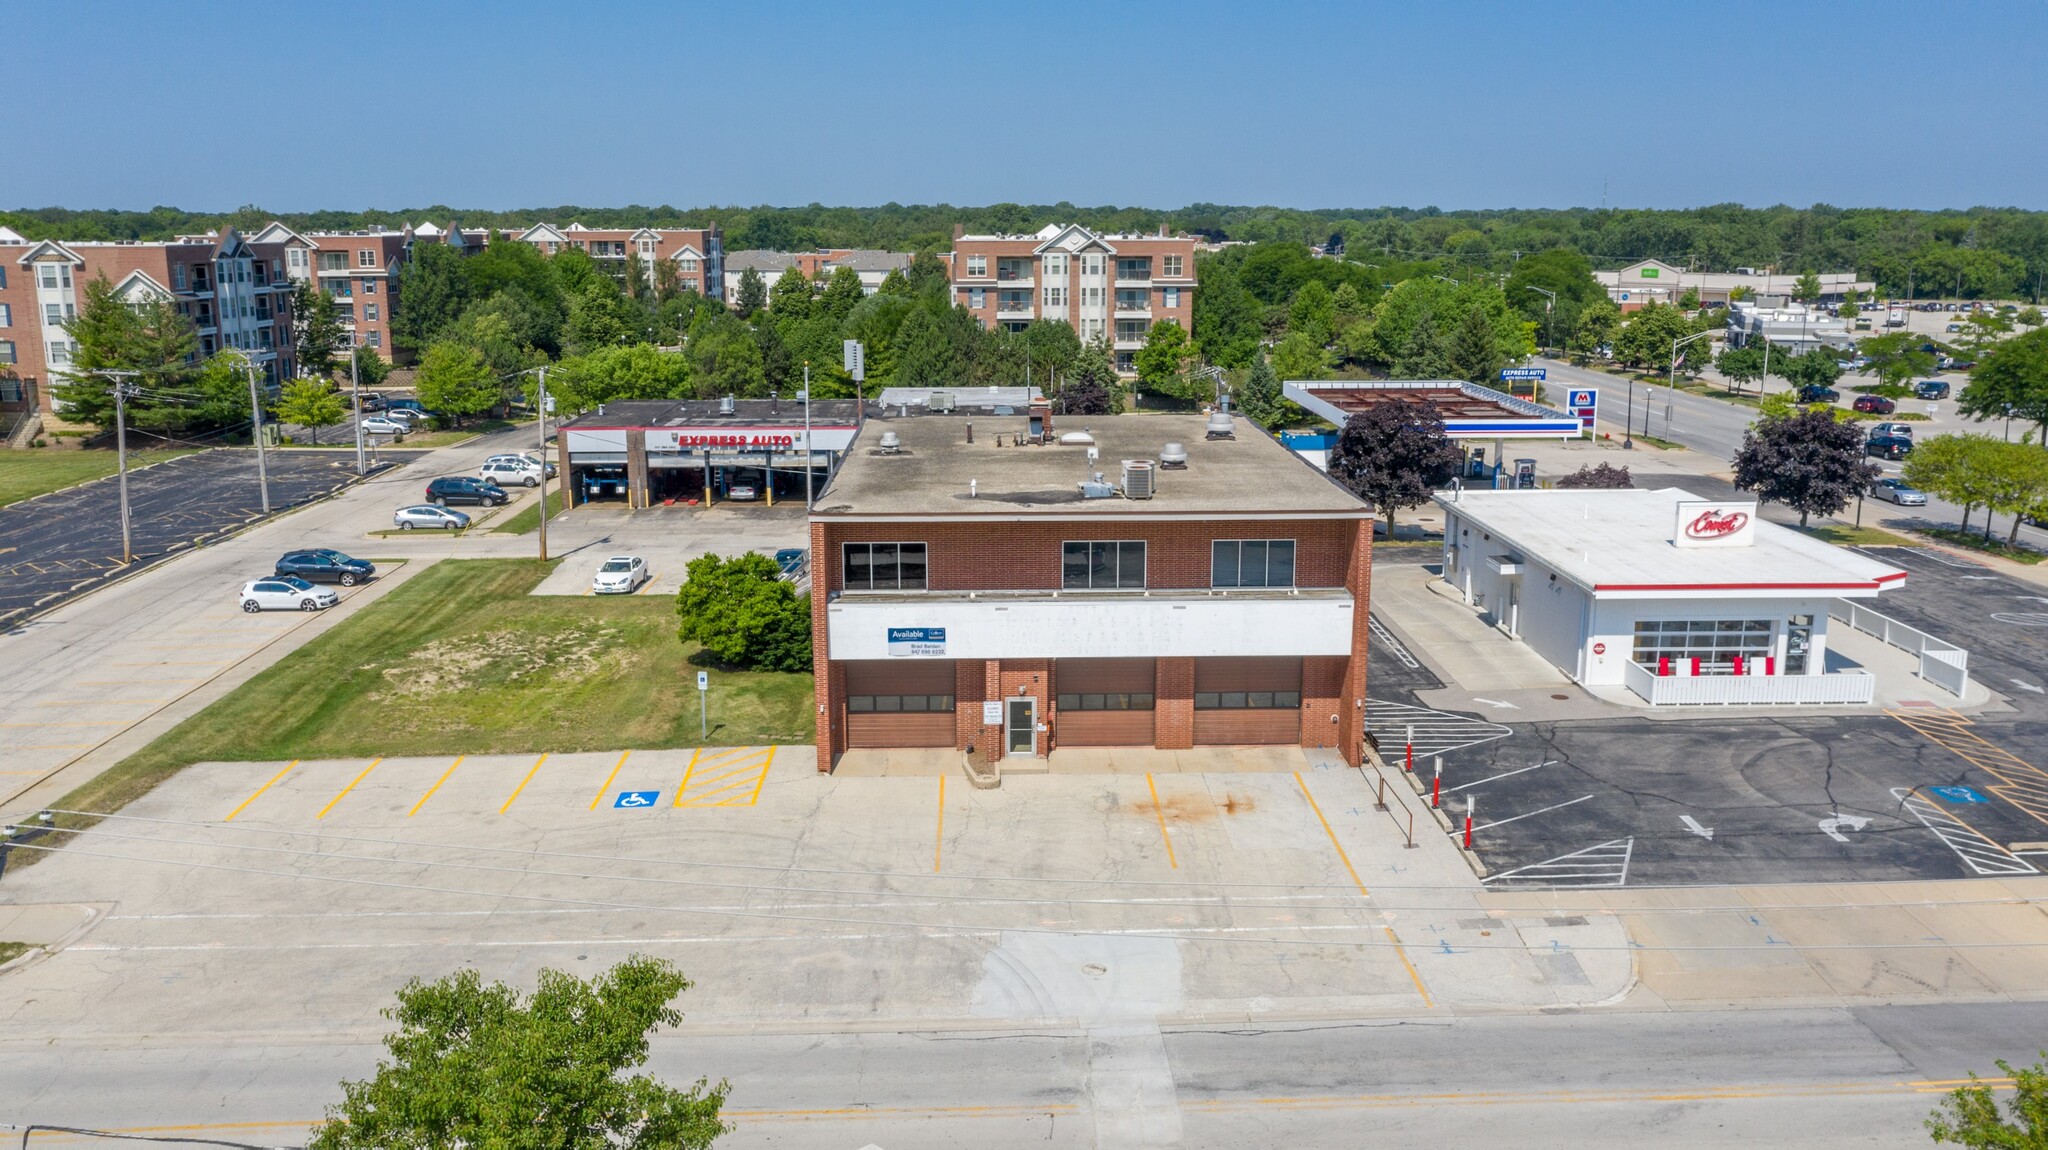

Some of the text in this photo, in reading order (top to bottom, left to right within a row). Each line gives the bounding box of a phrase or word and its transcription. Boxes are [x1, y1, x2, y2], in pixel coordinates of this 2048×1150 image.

[679, 435, 792, 446] EXPRESS AUTO
[892, 630, 924, 638] Available
